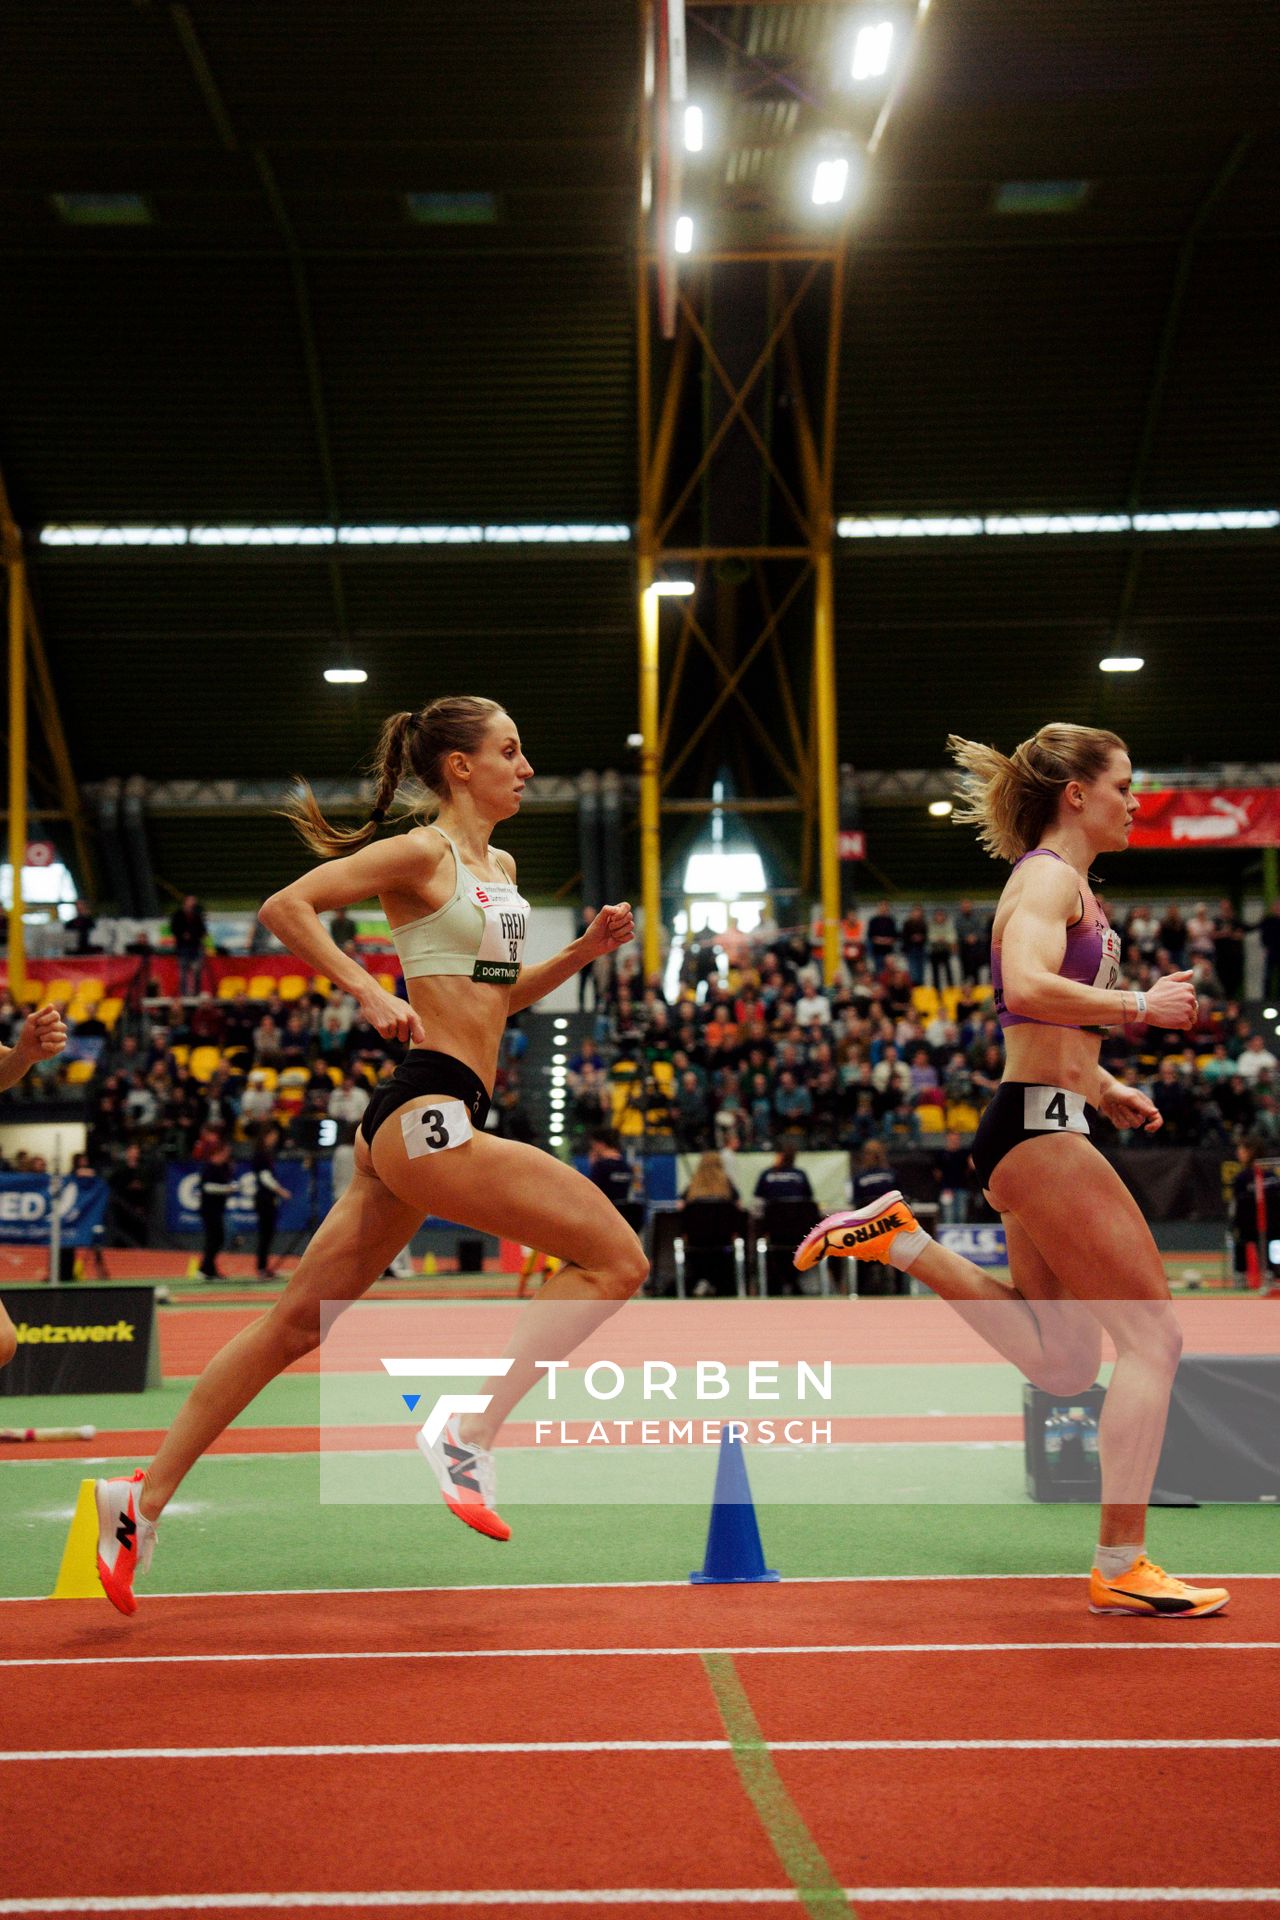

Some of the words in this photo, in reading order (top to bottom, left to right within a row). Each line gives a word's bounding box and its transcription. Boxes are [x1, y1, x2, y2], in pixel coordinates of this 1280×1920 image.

[509, 941, 518, 961] 58
[482, 967, 515, 978] DORTMD
[1045, 1092, 1069, 1127] 4
[421, 1110, 449, 1149] 3
[842, 1213, 907, 1247] NITRO
